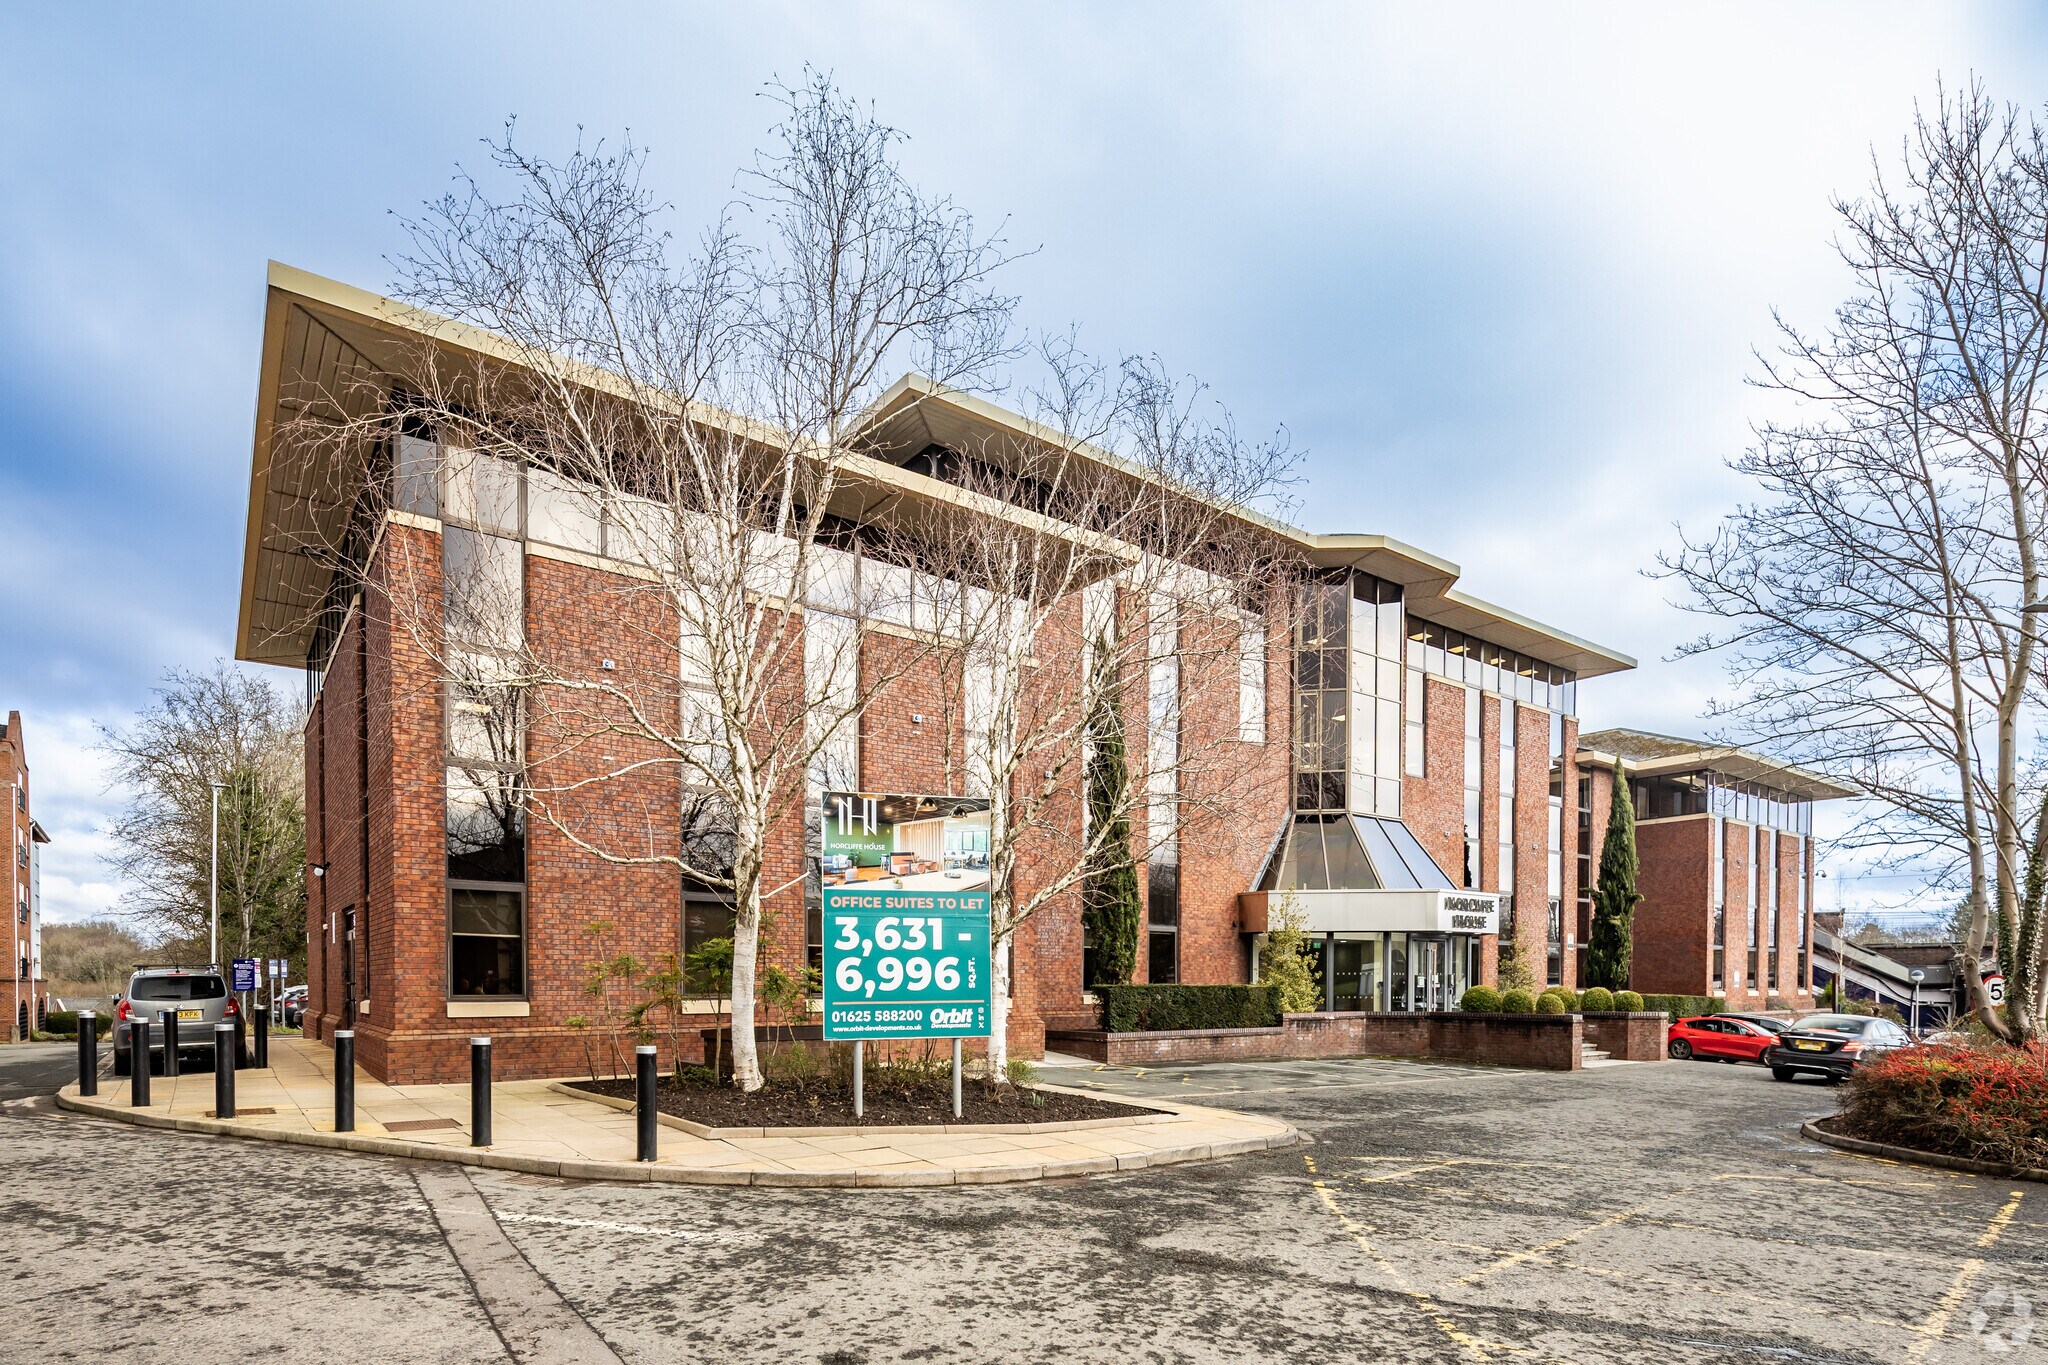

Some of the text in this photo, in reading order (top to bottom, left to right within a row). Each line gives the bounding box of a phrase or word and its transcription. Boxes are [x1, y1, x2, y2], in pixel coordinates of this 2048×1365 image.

[830, 896, 984, 910] OFFICE SUITES TO LET
[834, 916, 943, 957] 3,631
[835, 956, 961, 998] 6,996
[1990, 983, 2002, 1000] 5
[831, 1009, 923, 1022] 01625 588200
[930, 1008, 973, 1024] Orbit
[832, 1024, 922, 1032] www.orbit-developments.co.uk
